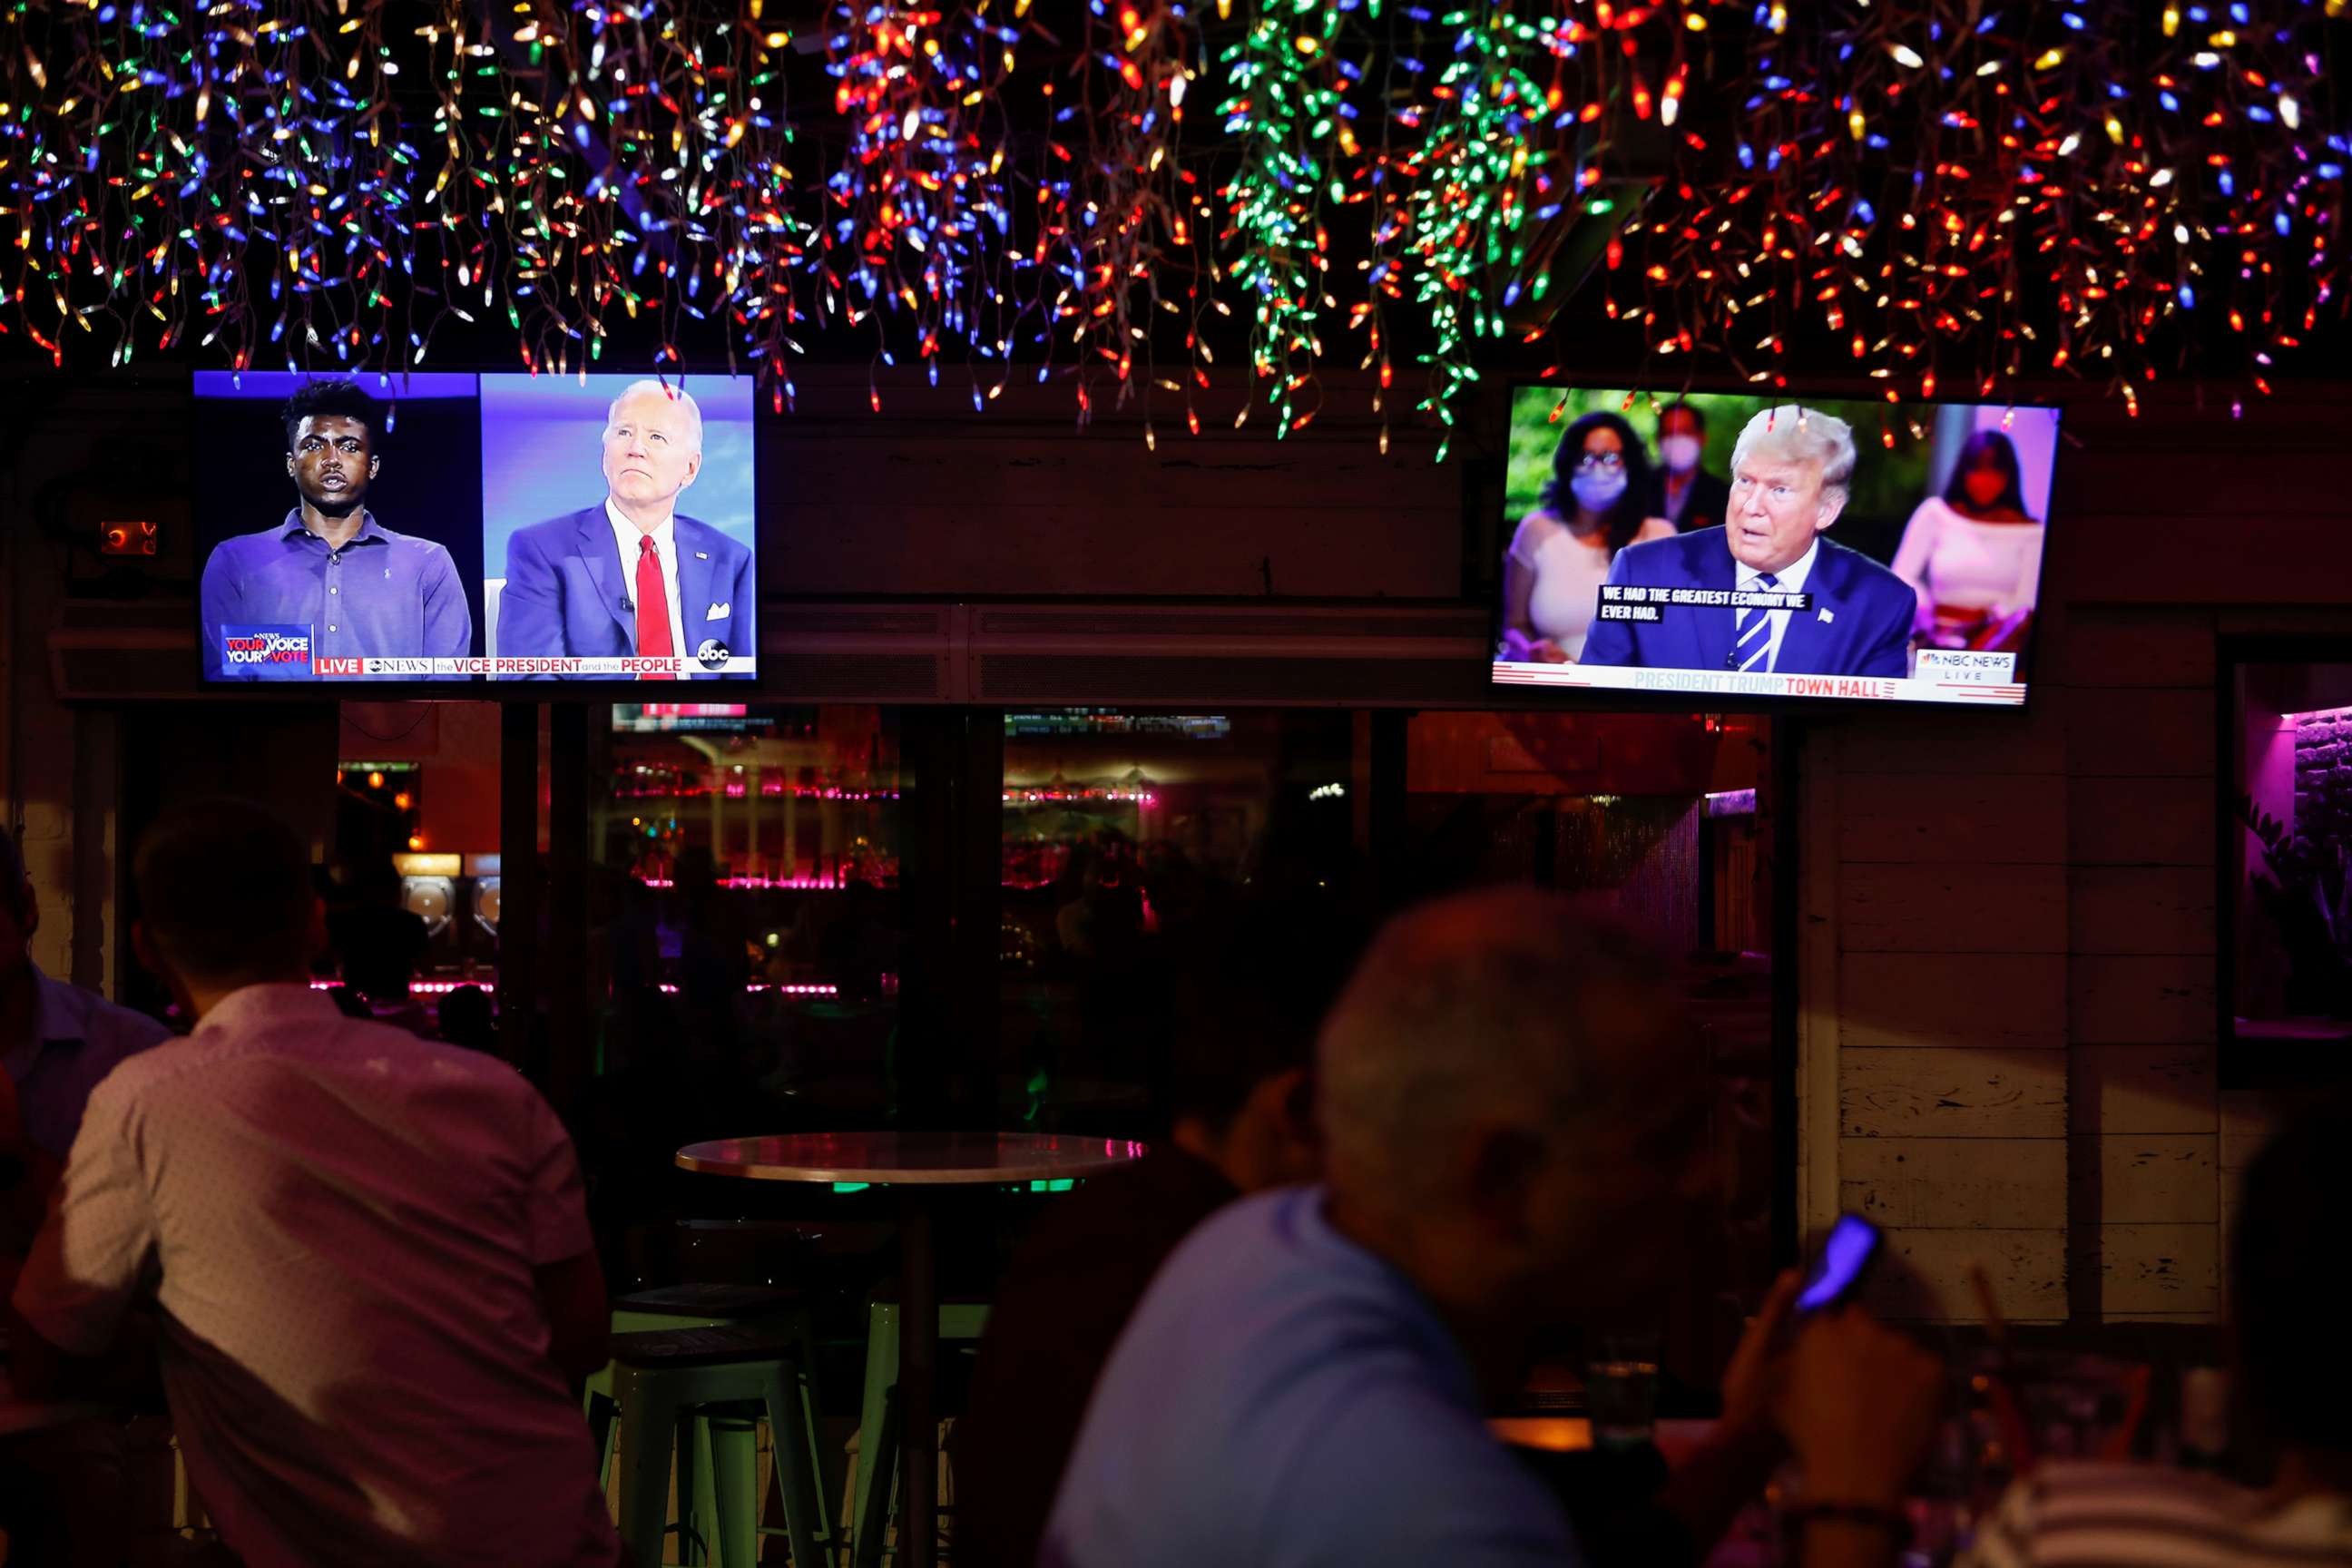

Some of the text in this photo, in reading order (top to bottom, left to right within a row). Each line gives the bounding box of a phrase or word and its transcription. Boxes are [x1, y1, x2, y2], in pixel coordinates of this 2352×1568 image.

[1602, 586, 1805, 608] WE HAD THE GREATEST ECONOMY WE
[1601, 605, 1659, 621] EVER HAD.
[228, 639, 309, 651] YOUR VOICE
[227, 651, 308, 663] YOUR VOTE
[697, 644, 730, 662] abc
[319, 659, 358, 673] LIVE
[384, 660, 428, 671] NEWS
[436, 659, 681, 672] the VICE PRESIDENT and the PEOPLE
[1943, 654, 2011, 669] NBC NEWS
[1945, 671, 1982, 681] LIVE
[1634, 671, 1879, 698] PRESIDENT TRUMP TOWN HALL
